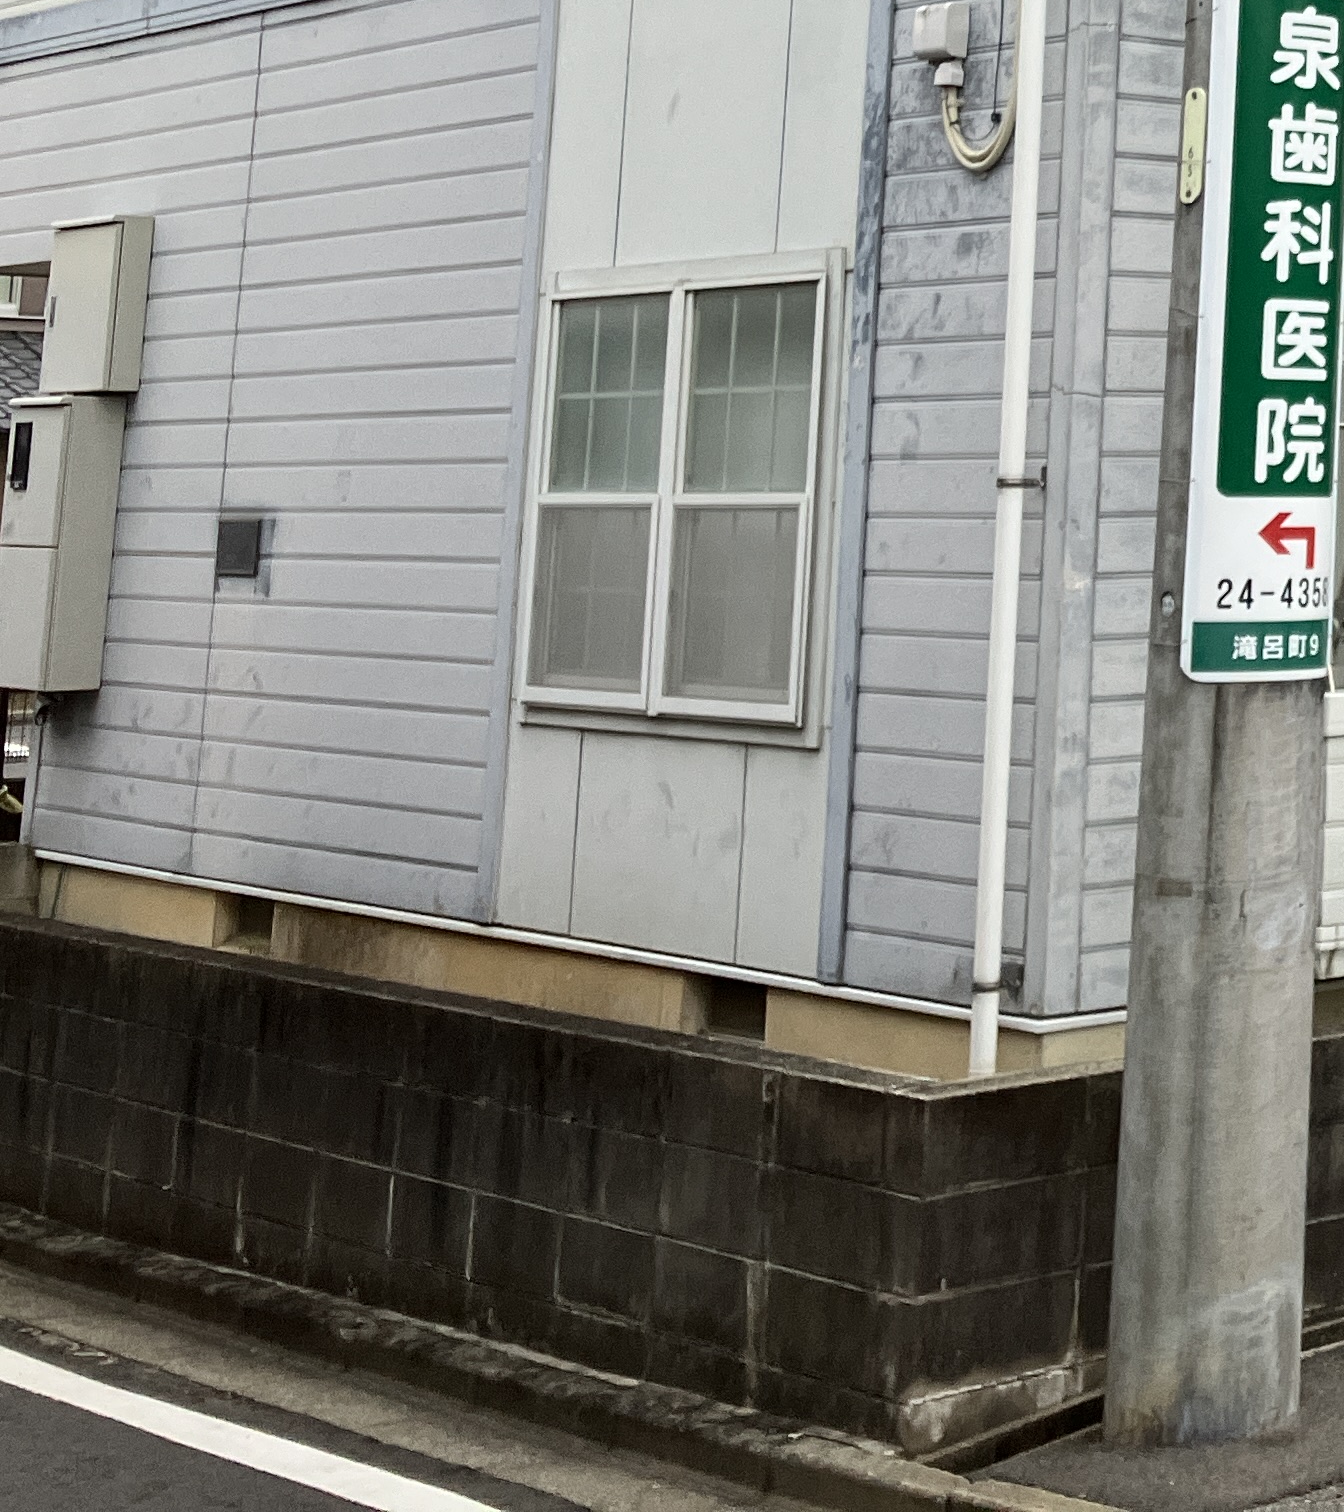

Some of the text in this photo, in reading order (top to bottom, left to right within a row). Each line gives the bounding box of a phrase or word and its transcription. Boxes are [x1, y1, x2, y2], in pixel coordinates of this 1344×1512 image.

[1254, 6, 1341, 483] 泉歯科医院
